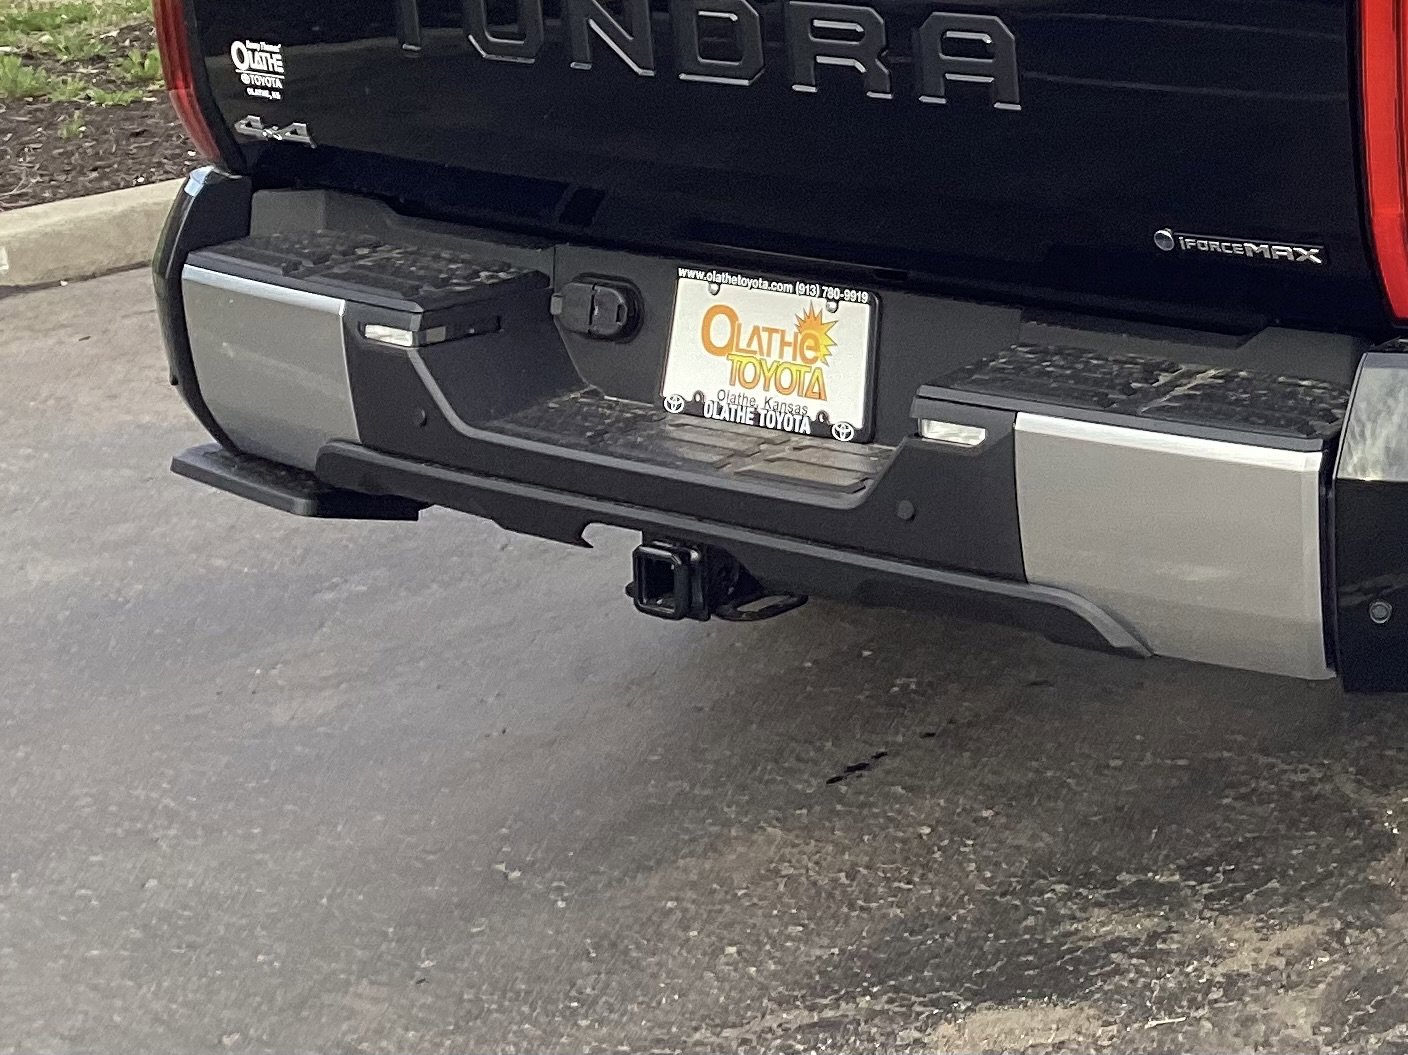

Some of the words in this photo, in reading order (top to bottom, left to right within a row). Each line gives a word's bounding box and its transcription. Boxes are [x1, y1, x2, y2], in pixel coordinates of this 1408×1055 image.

[230, 40, 285, 74] OLATHE
[250, 74, 283, 89] TOYOTA
[678, 266, 794, 294] www.olathetoyota.com
[795, 281, 821, 299] (913)
[822, 285, 869, 304] 780-9919
[726, 353, 828, 402] TOYOTA
[703, 399, 755, 426] OLATHE
[758, 408, 811, 435] TOYOTA
[716, 389, 759, 410] Olathe,
[764, 396, 809, 416] Kansas
